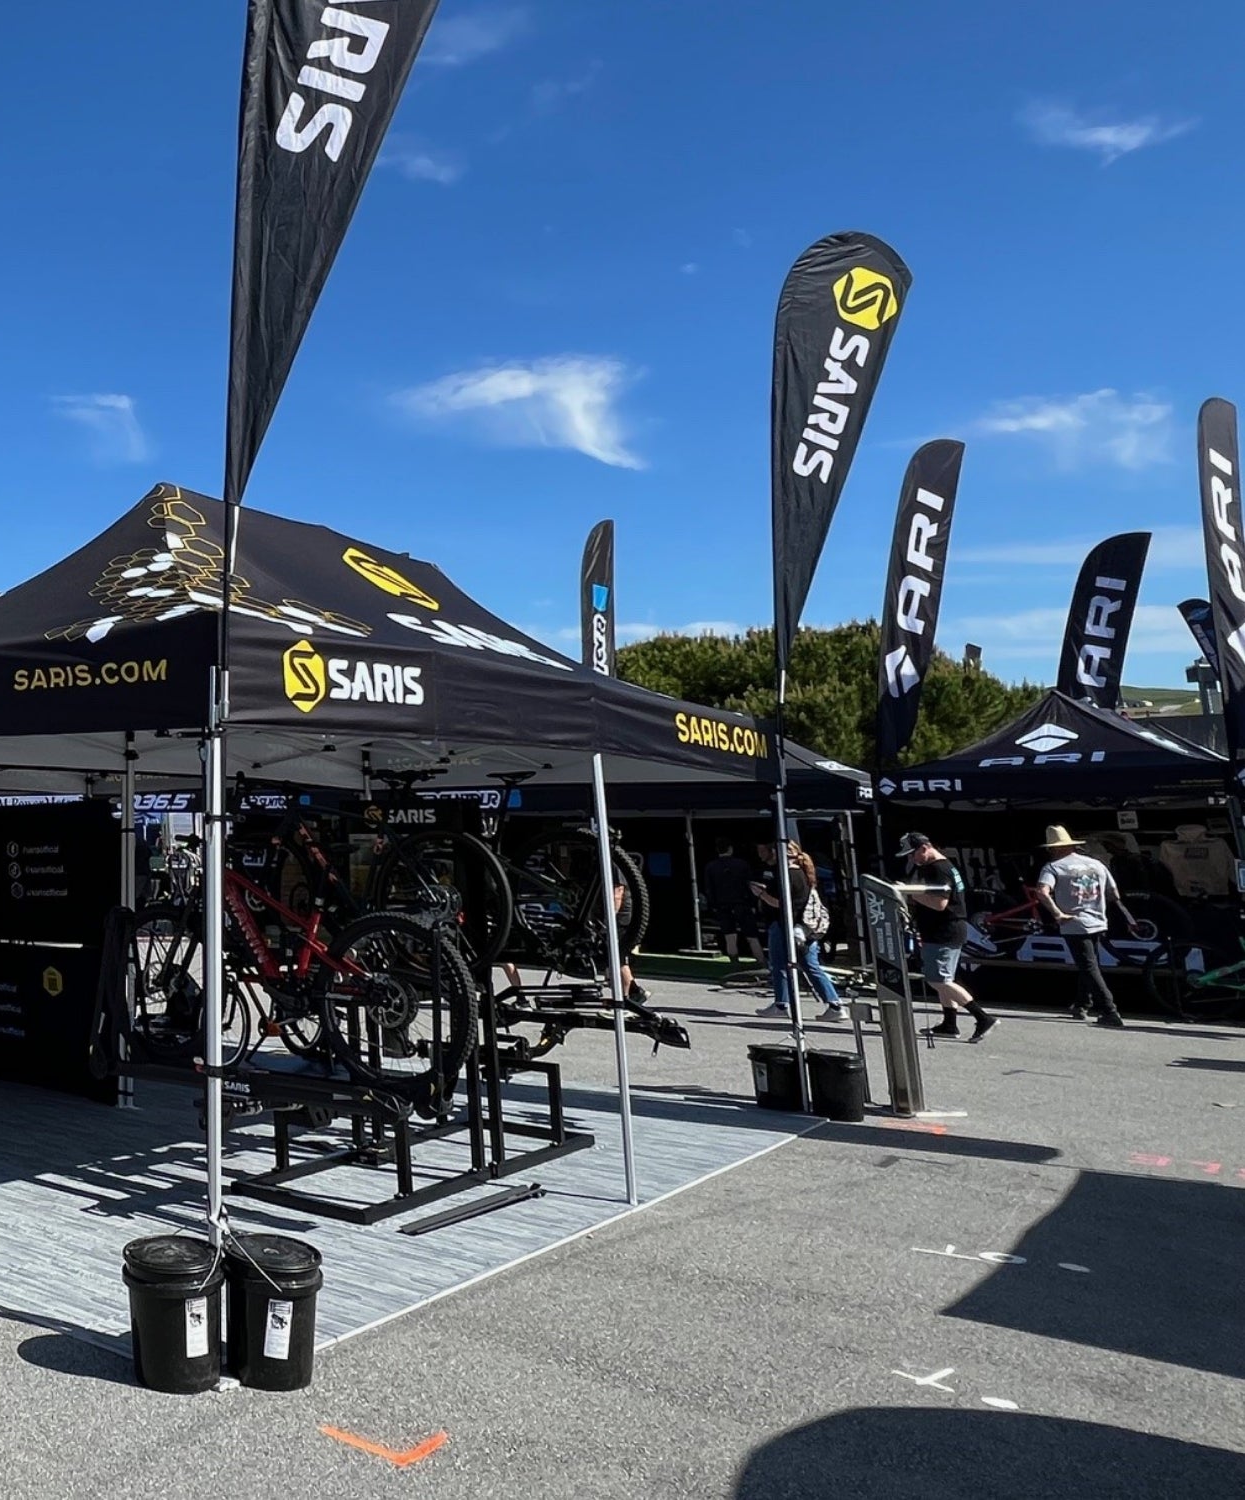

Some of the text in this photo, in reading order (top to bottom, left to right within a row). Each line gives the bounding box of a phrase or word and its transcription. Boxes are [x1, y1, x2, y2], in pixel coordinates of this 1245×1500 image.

[275, 0, 390, 163] RIS
[792, 326, 871, 484] SARIS
[896, 487, 945, 636] ARI
[1076, 576, 1127, 688] ARI
[13, 659, 168, 691] SARIS.COM
[328, 658, 425, 706] SARIS
[675, 712, 768, 759] SARIS.COM
[978, 751, 1105, 767] ARI
[902, 779, 962, 792] ARI
[387, 808, 437, 824] SARIS
